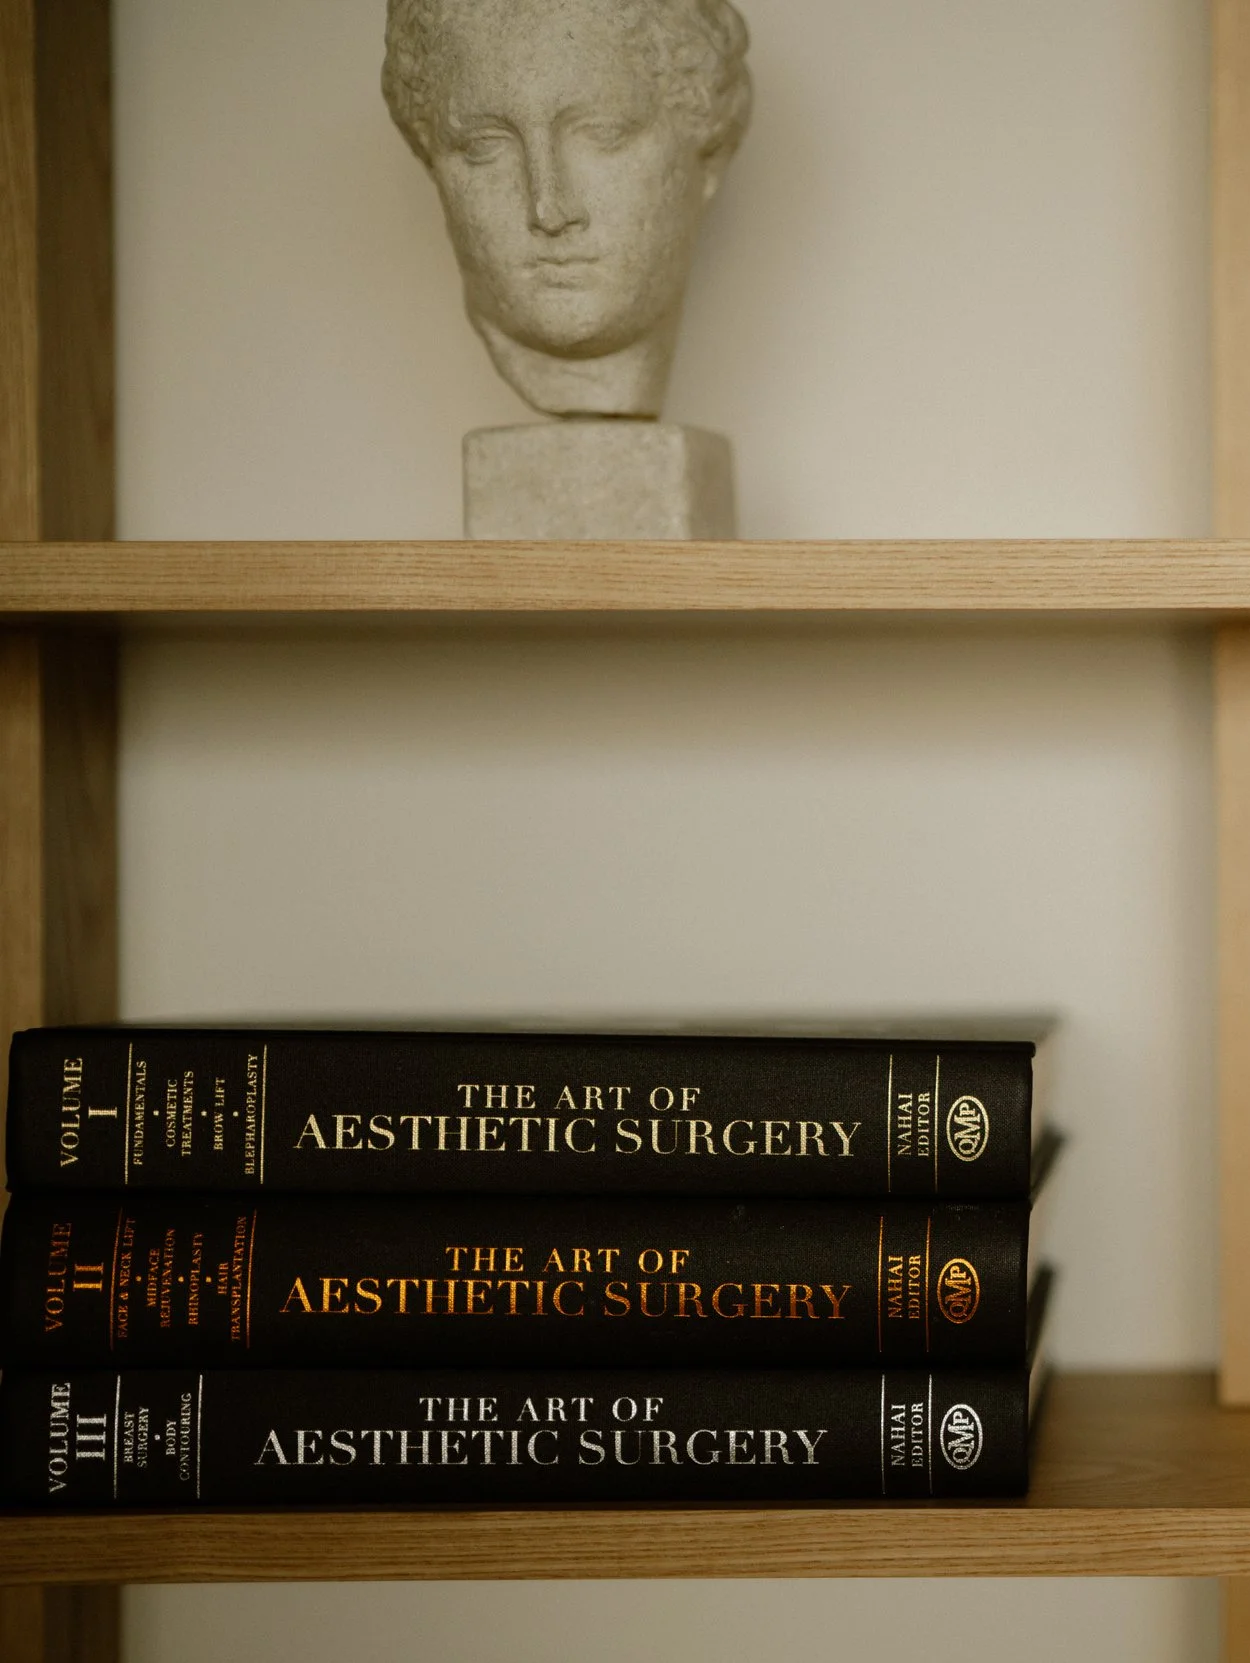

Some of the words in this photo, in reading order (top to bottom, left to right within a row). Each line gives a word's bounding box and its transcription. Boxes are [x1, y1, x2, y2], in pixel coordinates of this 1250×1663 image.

[60, 1057, 83, 1167] VOLUME
[88, 1106, 117, 1119] I
[133, 1061, 147, 1165] FUNDAMENTALS
[165, 1079, 178, 1148] COSMETIC
[182, 1071, 194, 1156] TREATMENTS
[215, 1077, 226, 1107] LIFT
[245, 1054, 258, 1174] BLEPHAROPLASTY
[457, 1084, 536, 1110] THE
[554, 1085, 632, 1111] ART
[649, 1086, 701, 1112] OF
[213, 1113, 225, 1150] BROW
[293, 1114, 596, 1154] AESTHETIC
[615, 1118, 862, 1157] SURGERY
[898, 1093, 912, 1156] NAHAI
[918, 1091, 930, 1157] EDITOR
[954, 1102, 981, 1155] QMP
[123, 1217, 136, 1248] LIFT
[45, 1223, 72, 1332] VOLUME
[73, 1262, 104, 1292] II
[120, 1252, 132, 1287] NECK
[160, 1228, 176, 1328] REJUVENATION
[188, 1232, 204, 1325] RHINOPLASTY
[217, 1262, 229, 1295] HAIR
[231, 1216, 246, 1341] TRANSPLANTATION
[445, 1246, 524, 1272] THE
[543, 1248, 620, 1274] ART
[638, 1249, 690, 1274] OF
[888, 1255, 903, 1318] NAHAI
[908, 1254, 921, 1319] EDITOR
[120, 1292, 129, 1301] &
[279, 1277, 584, 1316] AESTHETIC
[604, 1281, 852, 1320] SURGERY
[945, 1265, 972, 1317] QMP
[419, 1397, 499, 1422] THE
[517, 1397, 594, 1422] ART
[612, 1396, 664, 1422] OF
[891, 1403, 906, 1466] NAHAI
[911, 1402, 923, 1467] EDITOR
[48, 1383, 71, 1493] VOLUME
[76, 1414, 107, 1461] III
[124, 1412, 135, 1464] BREAST
[137, 1406, 149, 1468] SURGERY
[165, 1419, 177, 1456] BODY
[179, 1392, 192, 1481] CONTOURING
[253, 1429, 559, 1466] AESTHETIC
[578, 1429, 827, 1466] SURGERY
[948, 1411, 975, 1465] QMP
